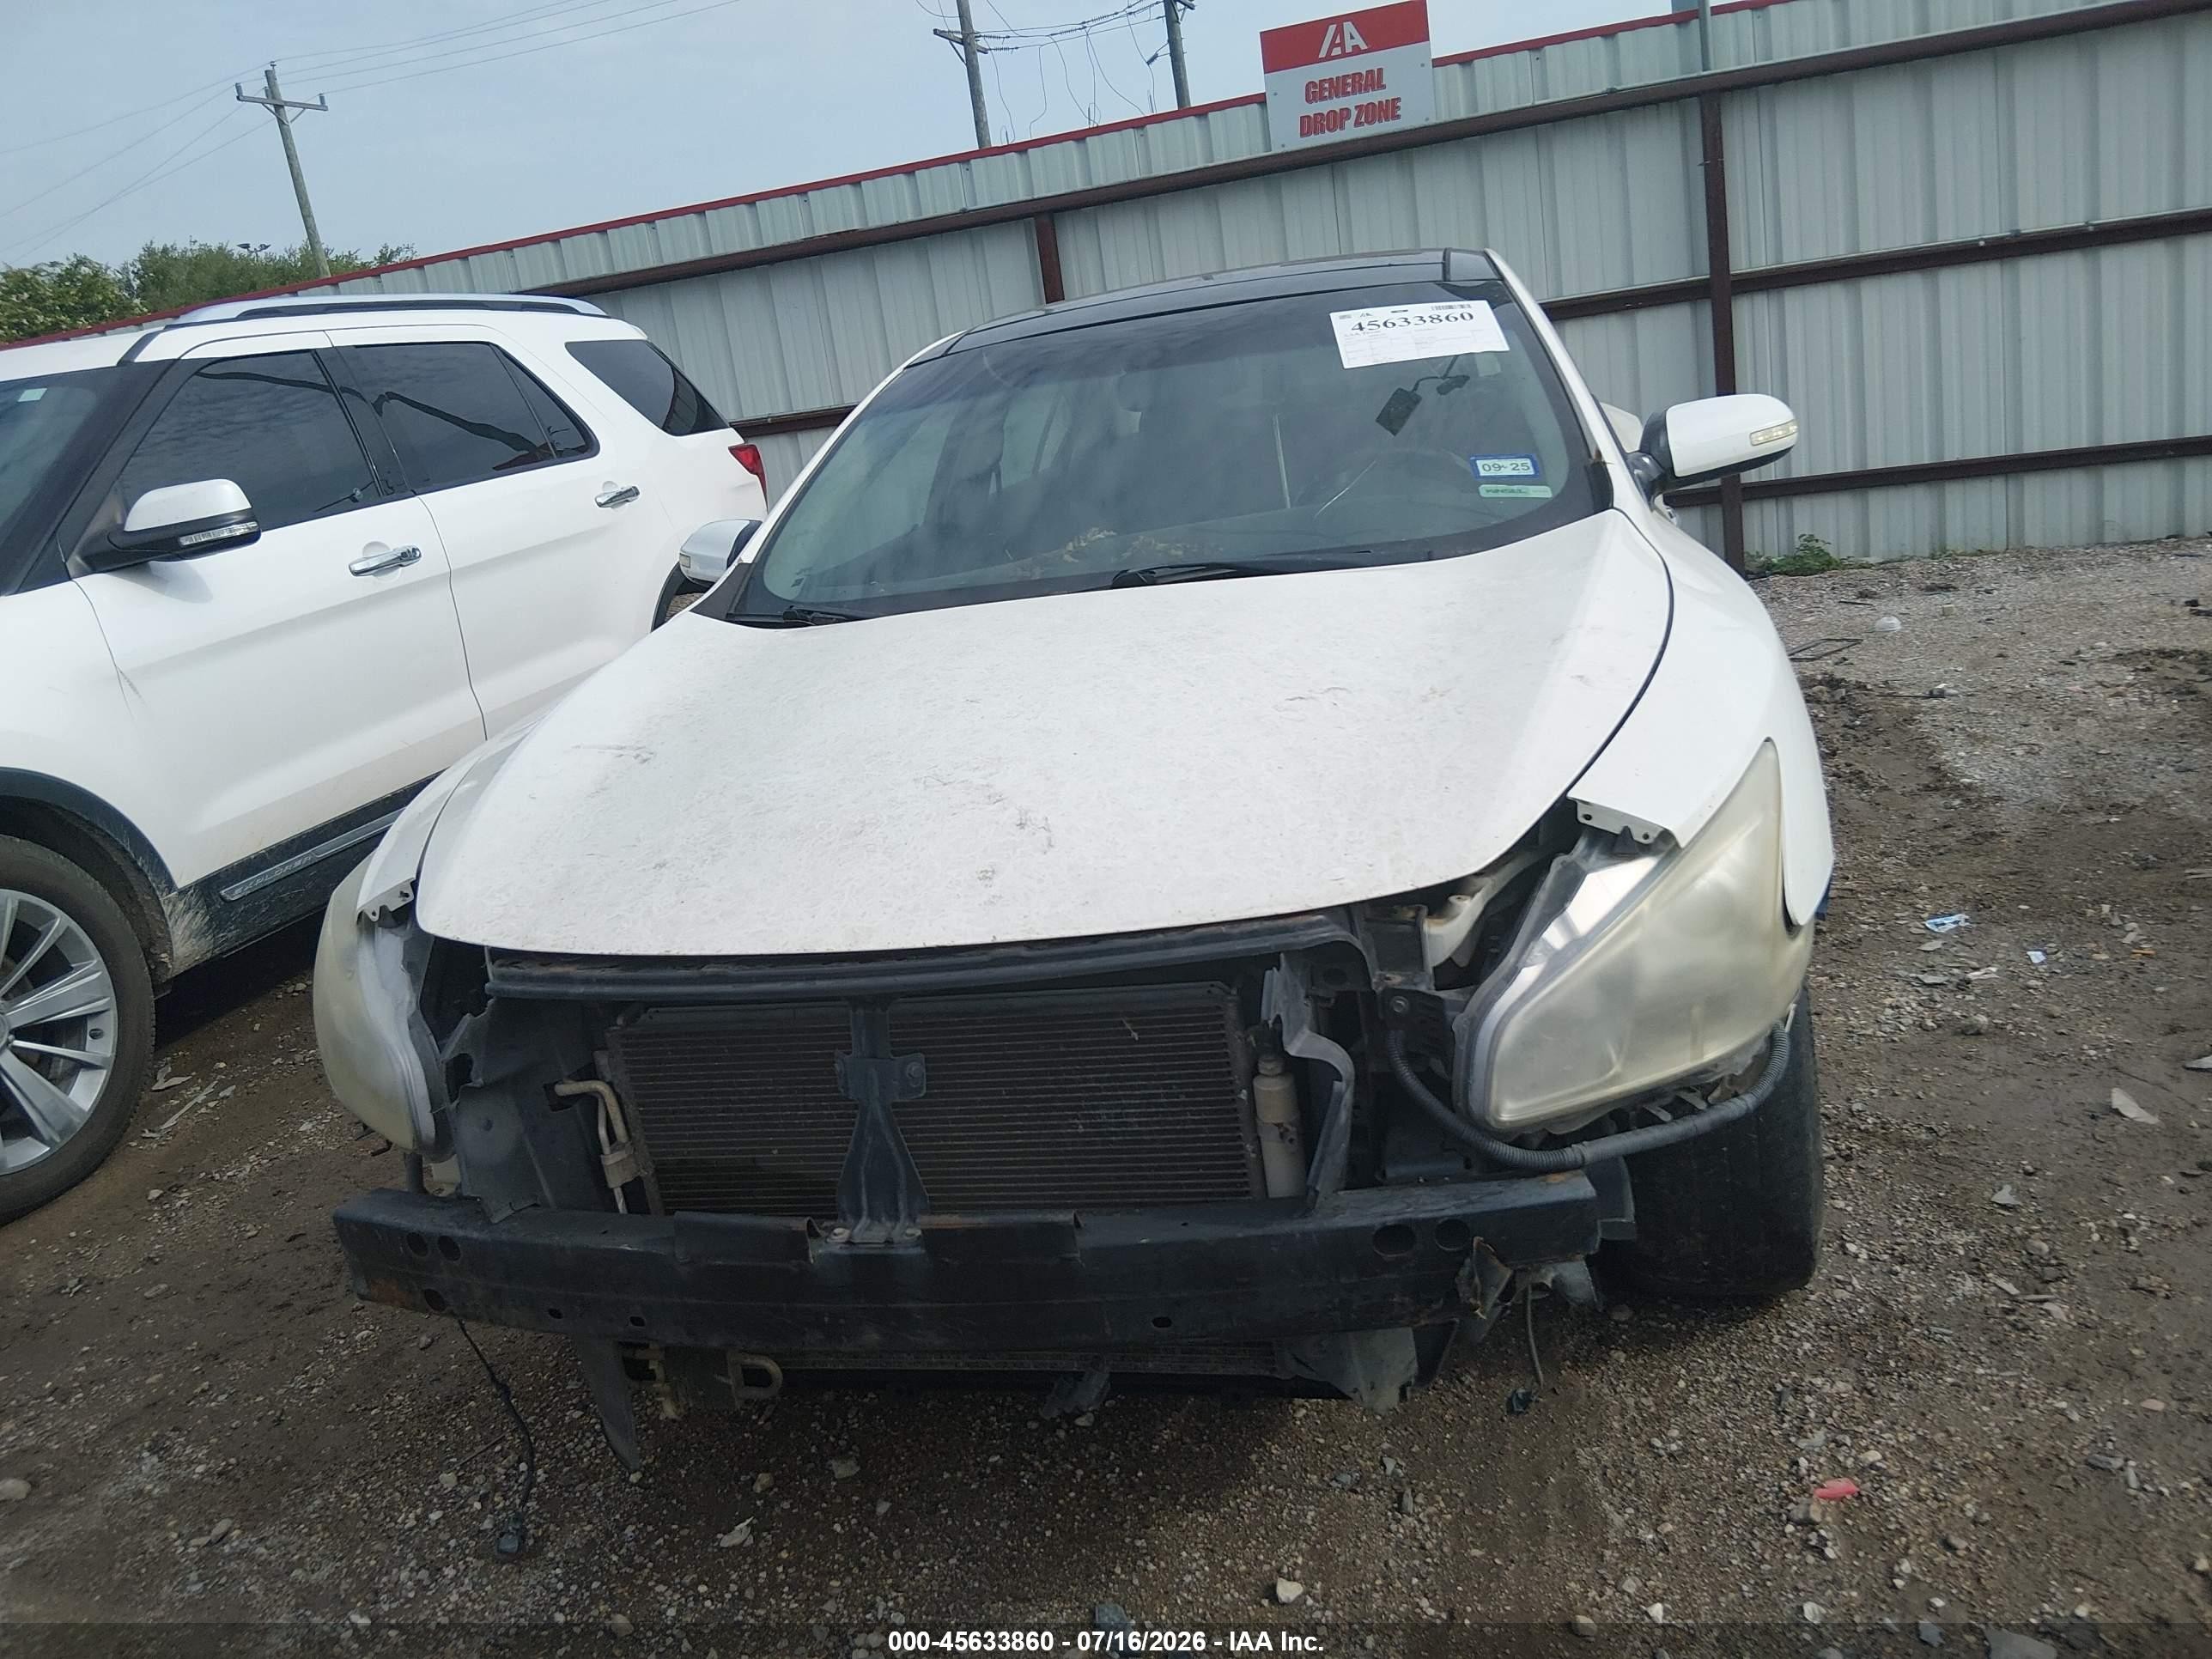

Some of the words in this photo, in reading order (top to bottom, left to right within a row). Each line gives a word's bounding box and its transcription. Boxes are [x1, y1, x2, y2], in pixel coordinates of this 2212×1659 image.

[1304, 68, 1387, 104] GENERAL
[1299, 107, 1352, 138] DROP
[1353, 97, 1401, 128] ZONE
[1351, 311, 1474, 332] 45633860
